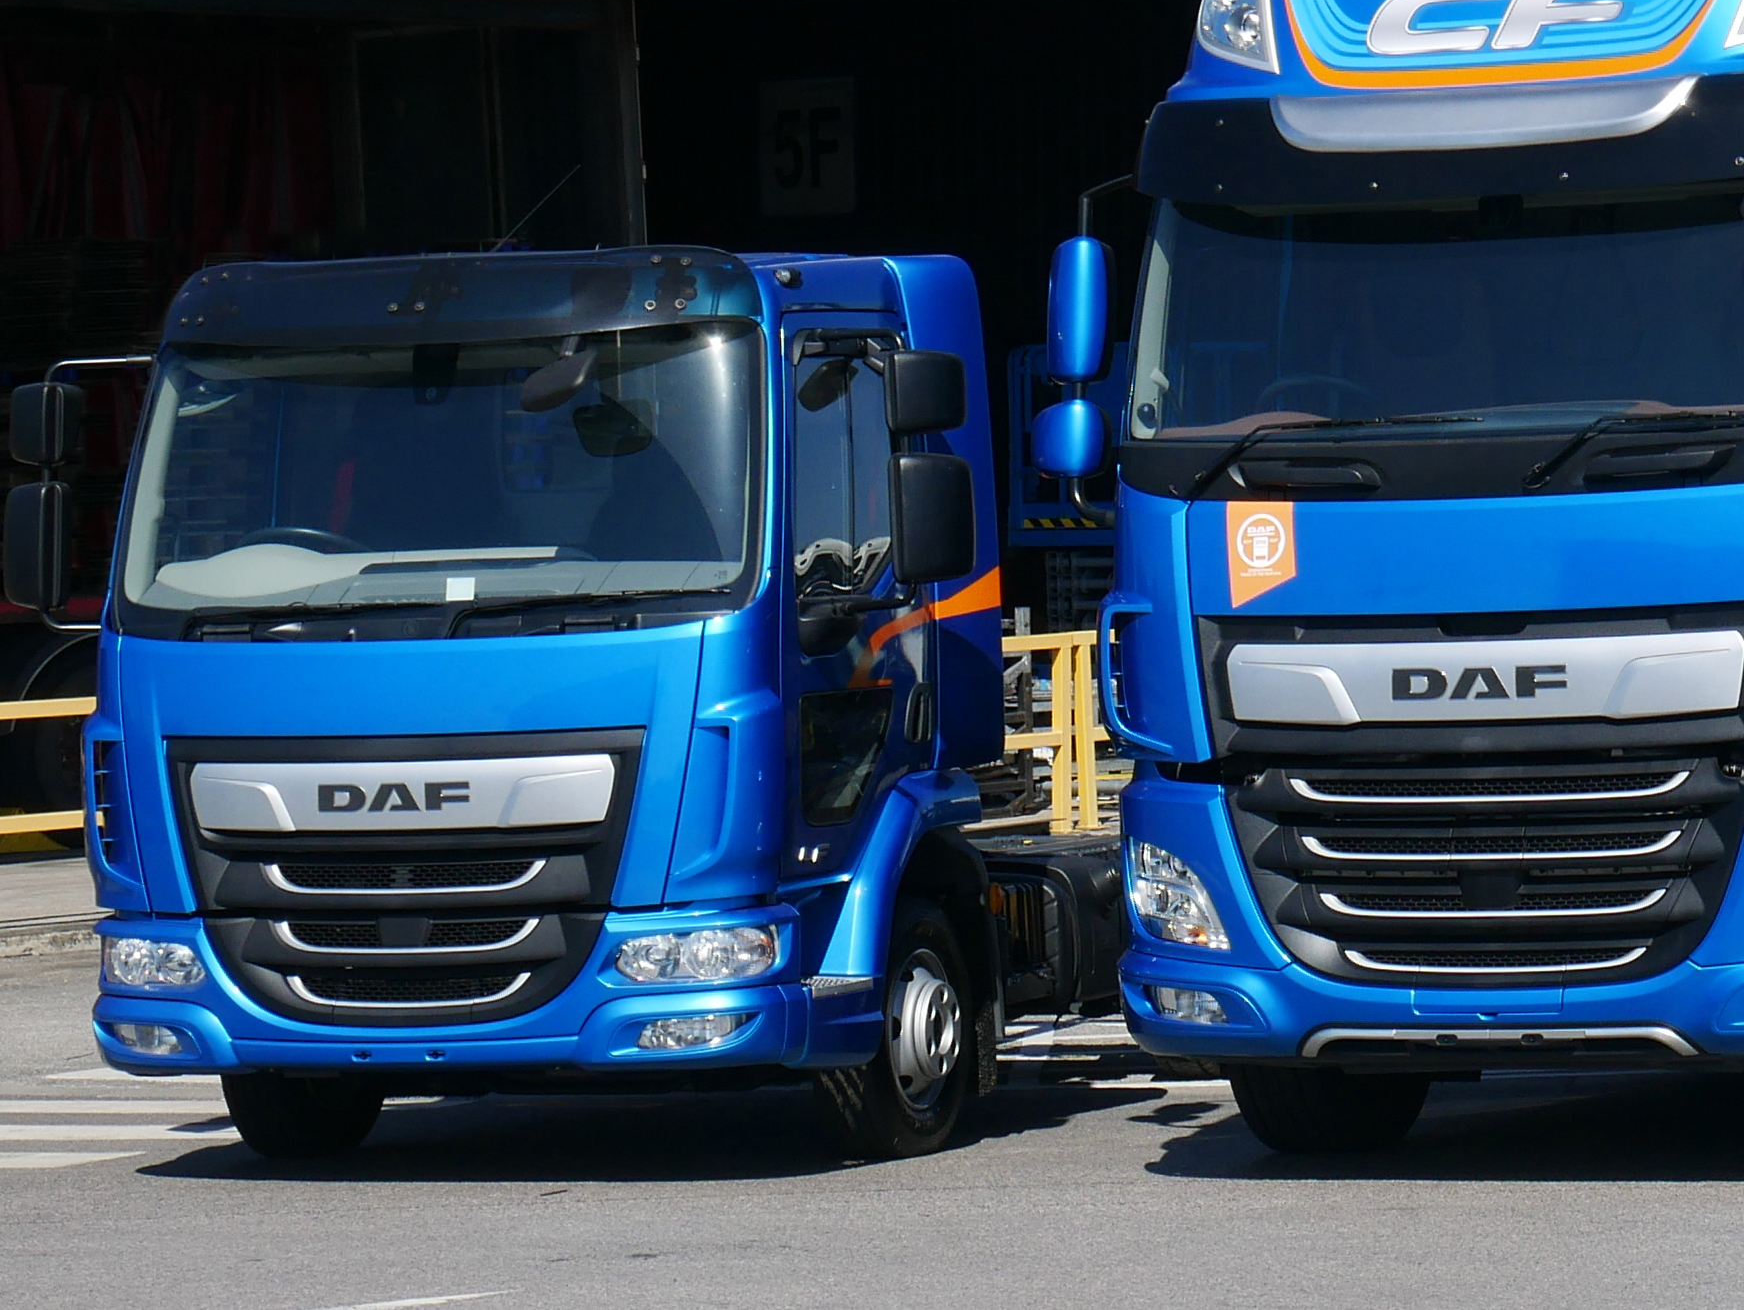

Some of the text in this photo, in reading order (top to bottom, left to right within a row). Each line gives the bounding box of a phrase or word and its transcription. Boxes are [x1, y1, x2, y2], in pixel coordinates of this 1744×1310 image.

[774, 106, 842, 190] 5F
[1246, 525, 1276, 534] DAF
[1391, 664, 1568, 701] DAF
[317, 780, 471, 813] DAF
